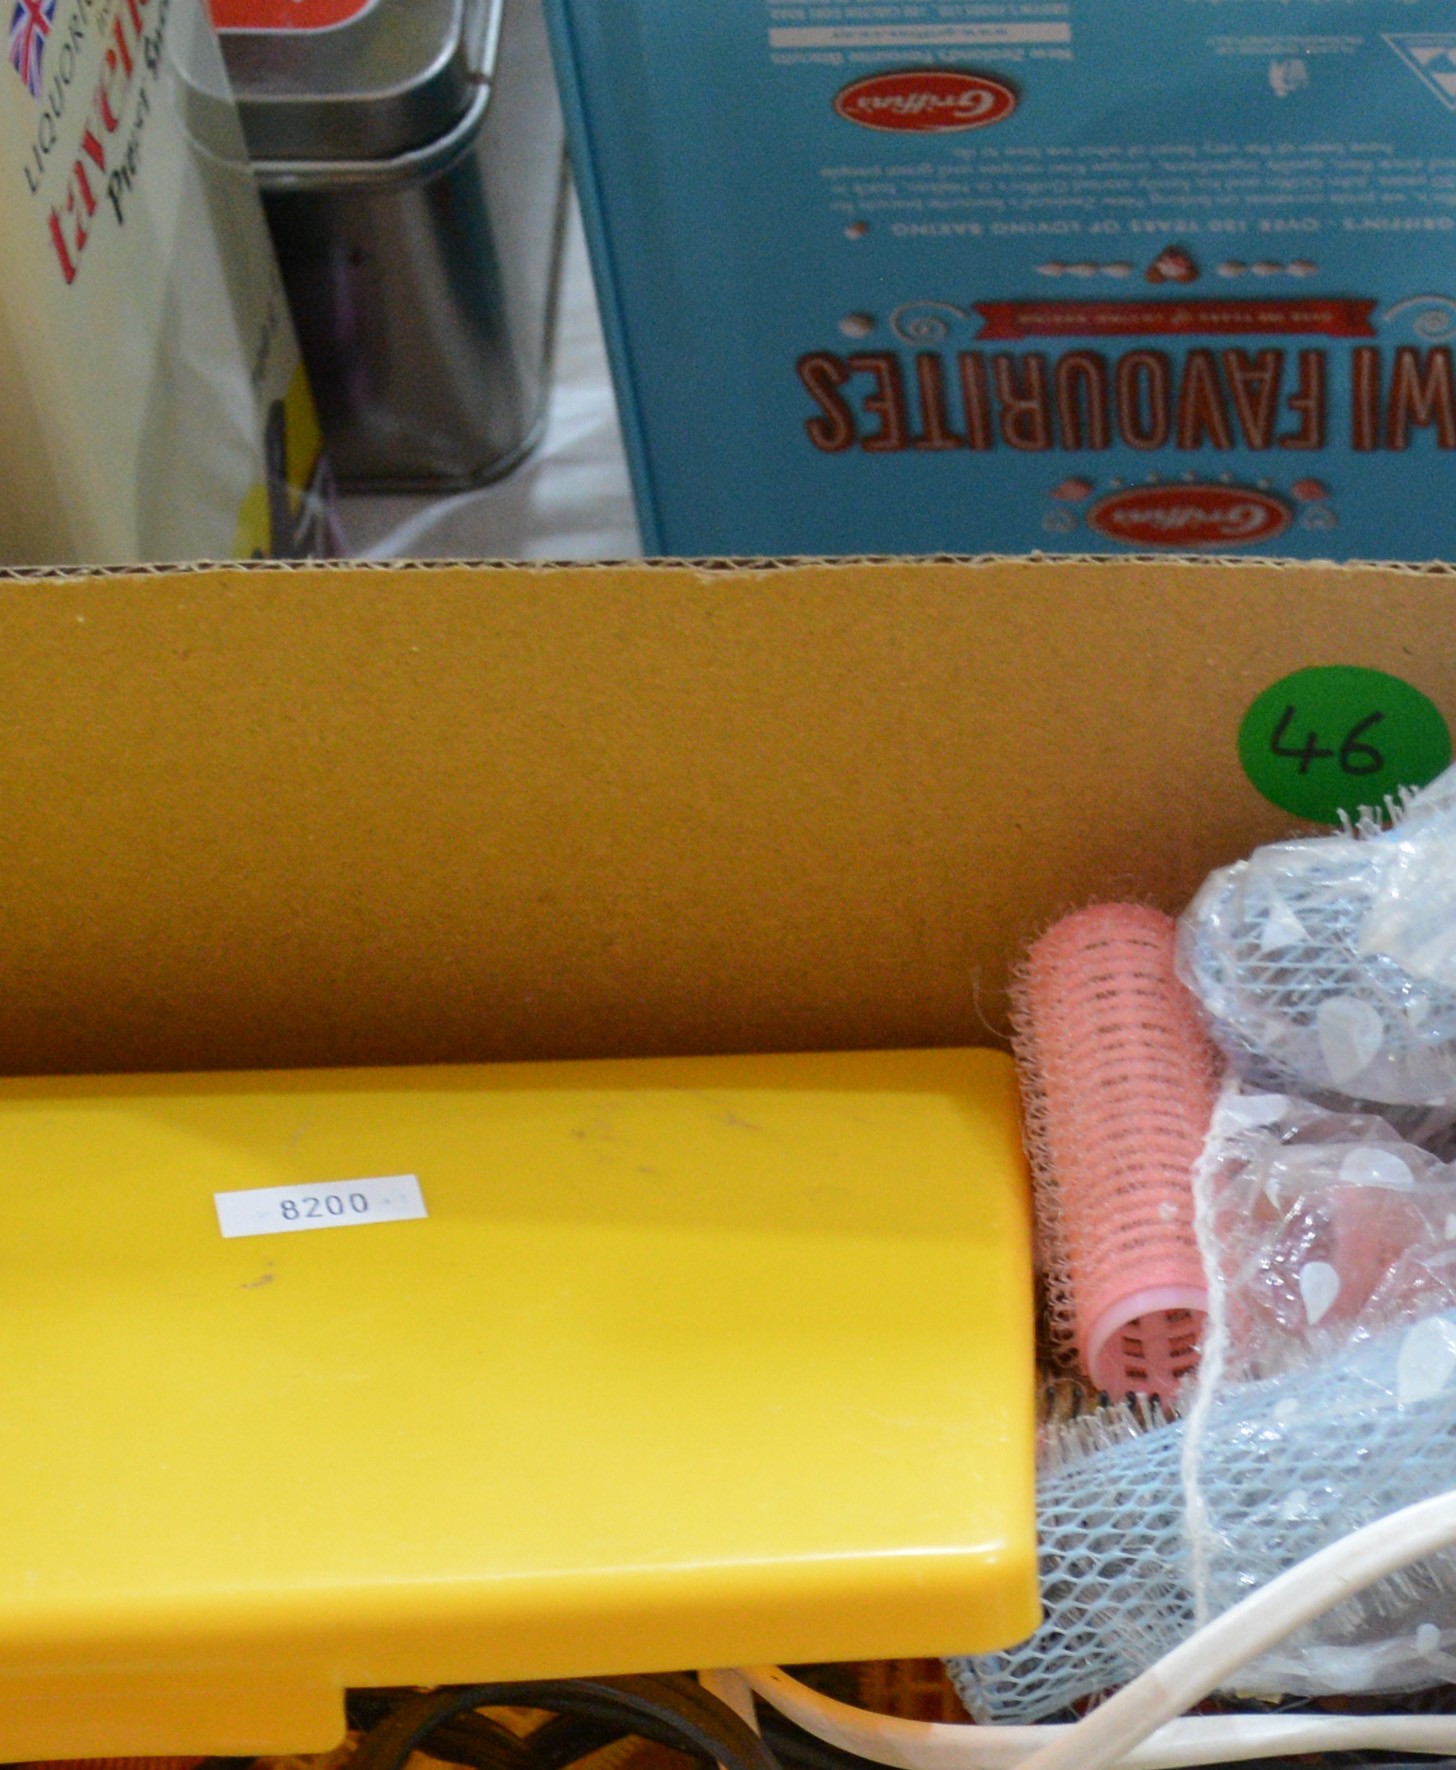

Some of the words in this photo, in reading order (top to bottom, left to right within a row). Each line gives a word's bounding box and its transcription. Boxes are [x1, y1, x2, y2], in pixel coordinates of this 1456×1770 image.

[46, 0, 147, 285] taven
[796, 347, 1326, 453] FAVOURITES
[1270, 704, 1386, 776] 46
[280, 1192, 370, 1221] 8200
